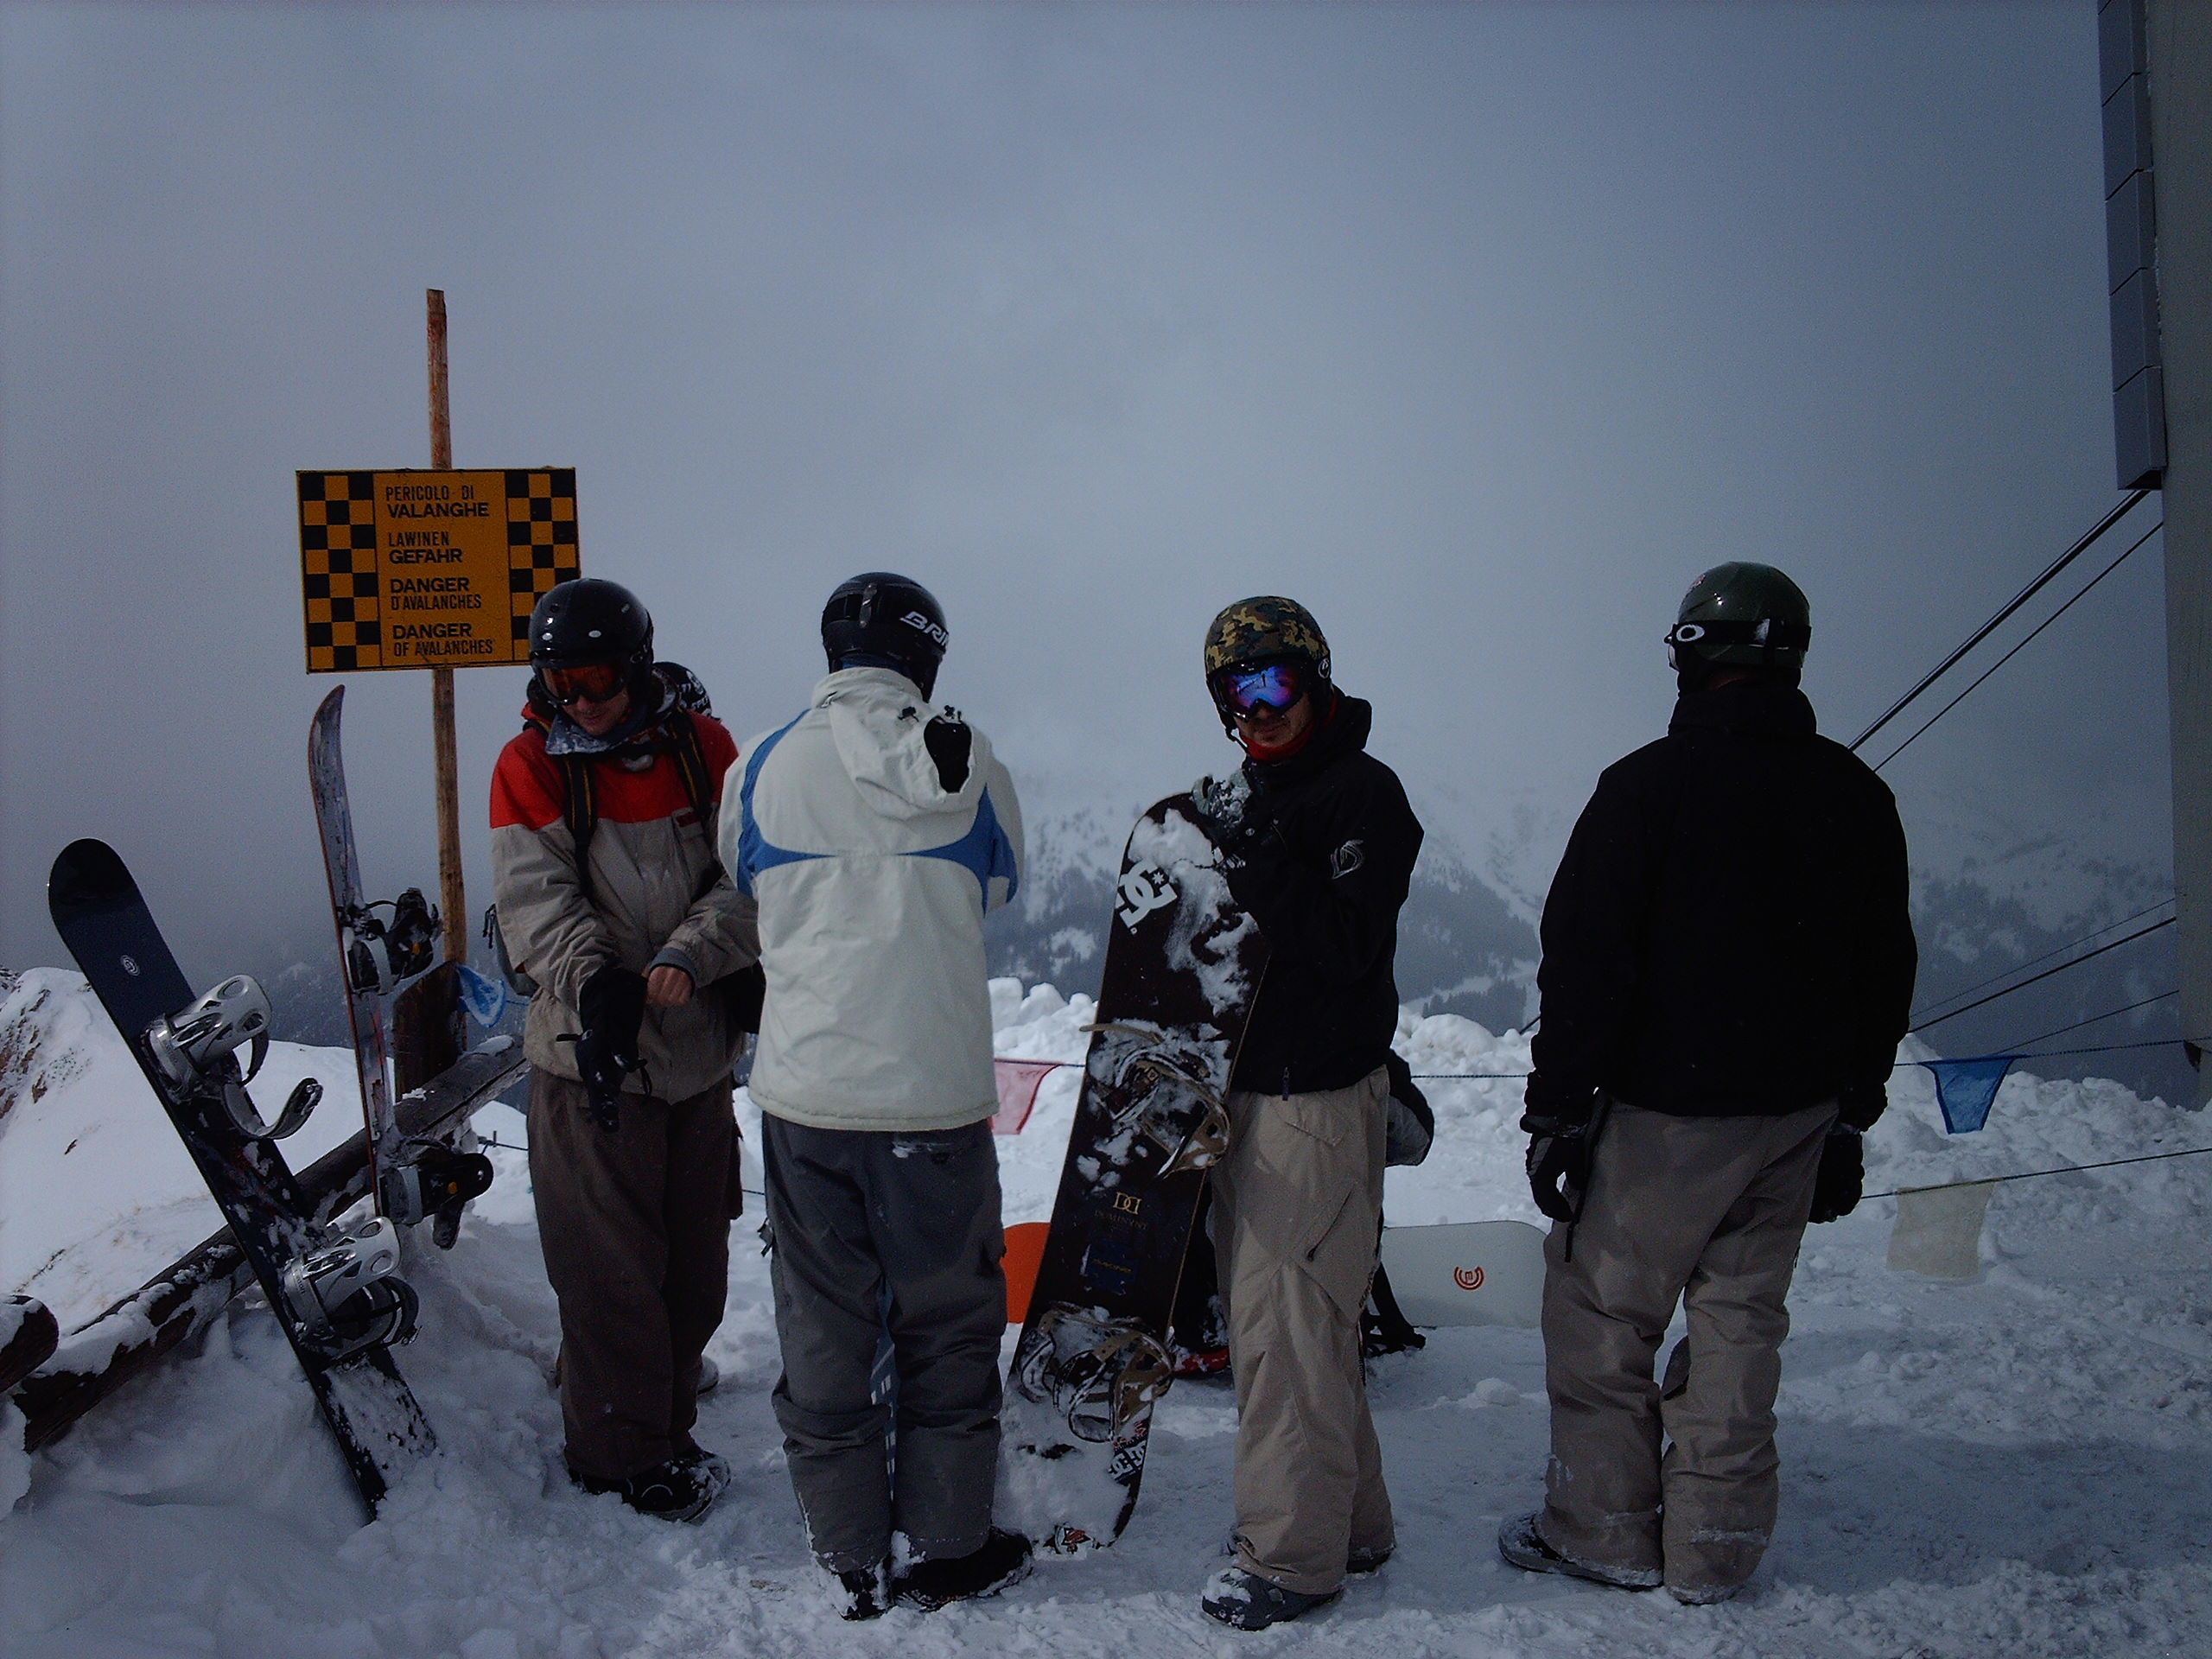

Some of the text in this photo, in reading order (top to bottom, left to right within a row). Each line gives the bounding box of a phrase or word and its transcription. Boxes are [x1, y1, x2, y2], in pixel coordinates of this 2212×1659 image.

[386, 486, 474, 500] PERICOLO DI
[387, 502, 490, 518] VALANGHE
[389, 531, 449, 547] LAWINEN
[389, 549, 462, 564] GEFAHR
[390, 577, 469, 593] DANGER
[391, 594, 481, 610] D'AVALANCHES
[392, 624, 472, 639] DANGER
[393, 639, 493, 657] OF AVALANCHES
